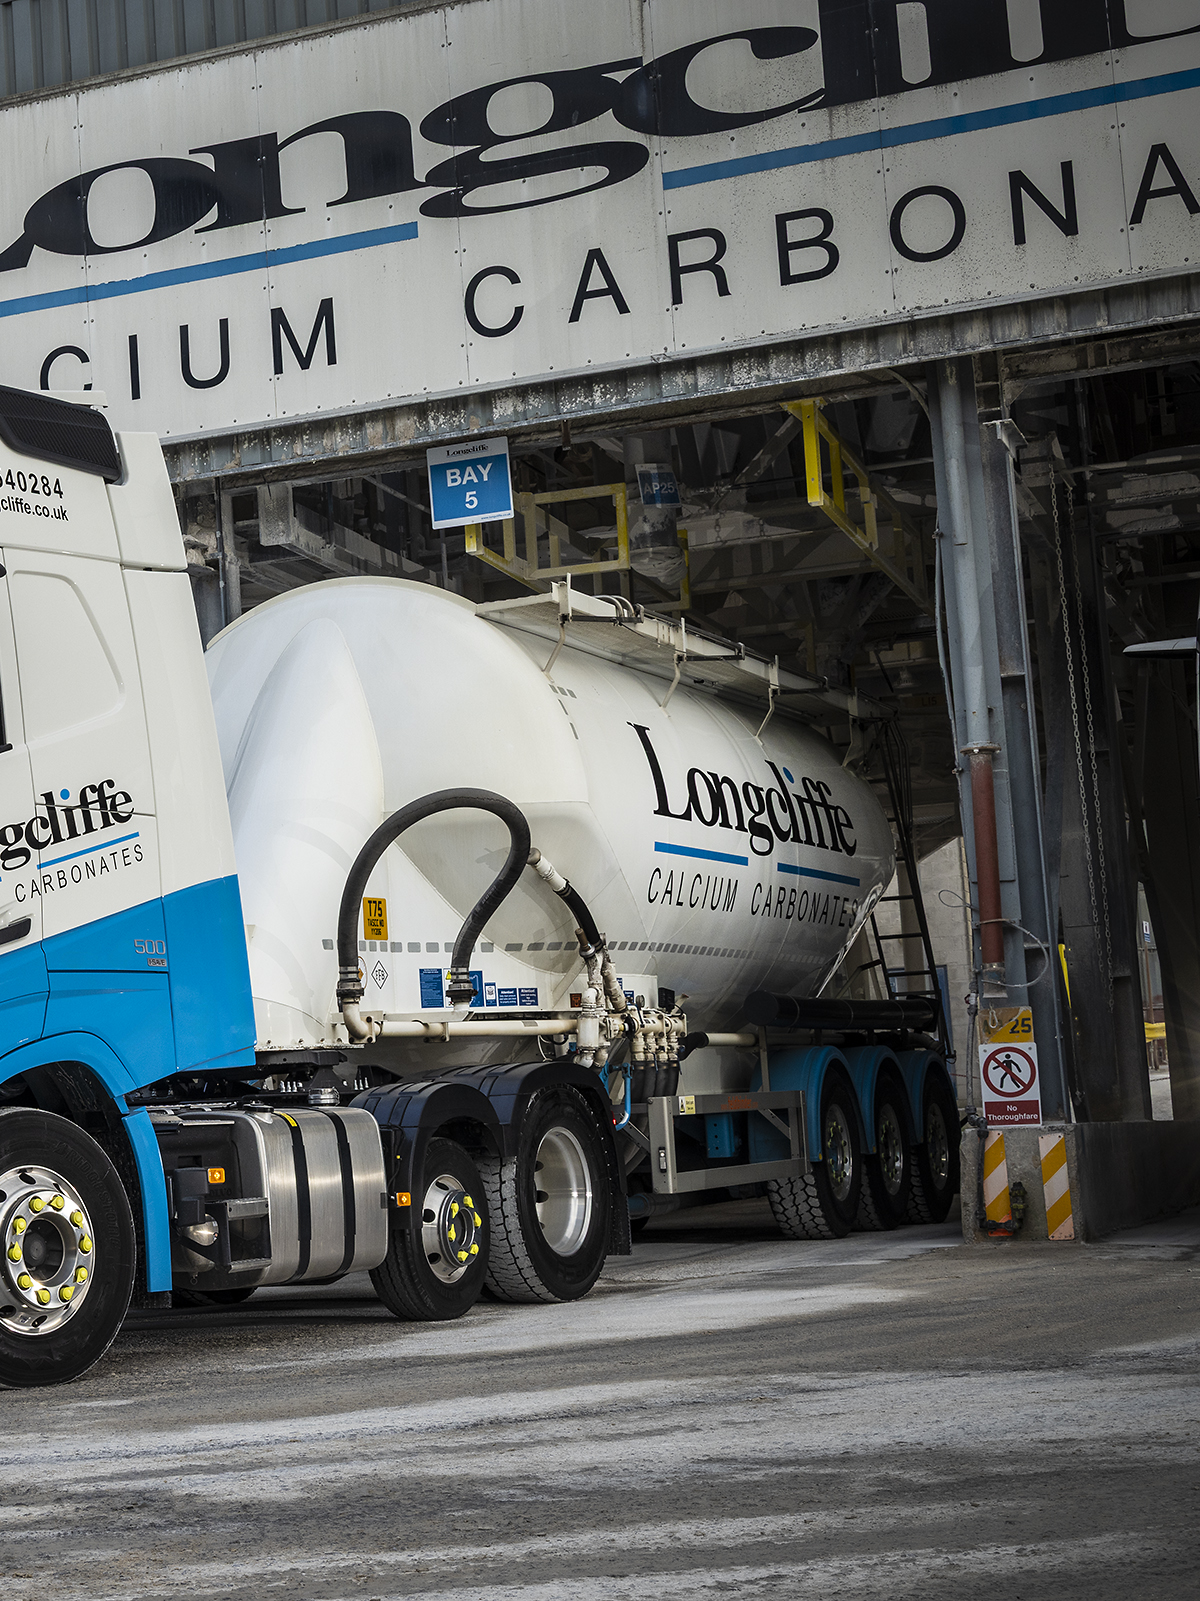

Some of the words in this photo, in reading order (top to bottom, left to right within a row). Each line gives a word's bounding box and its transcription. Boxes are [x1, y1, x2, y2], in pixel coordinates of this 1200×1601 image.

[464, 142, 1200, 338] CARBONA
[446, 443, 489, 457] Longcliffe
[446, 463, 492, 487] BAY
[643, 481, 675, 494] AP25
[465, 491, 478, 509] 5
[626, 721, 857, 856] Longcliffe
[15, 843, 144, 902] CARBONATES
[647, 867, 739, 913] CALCIUM
[751, 882, 858, 928] CARBONATES
[368, 900, 383, 917] T75
[134, 939, 166, 955] 500
[1008, 1017, 1031, 1034] 25
[987, 1113, 1039, 1122] Thoroughfare
